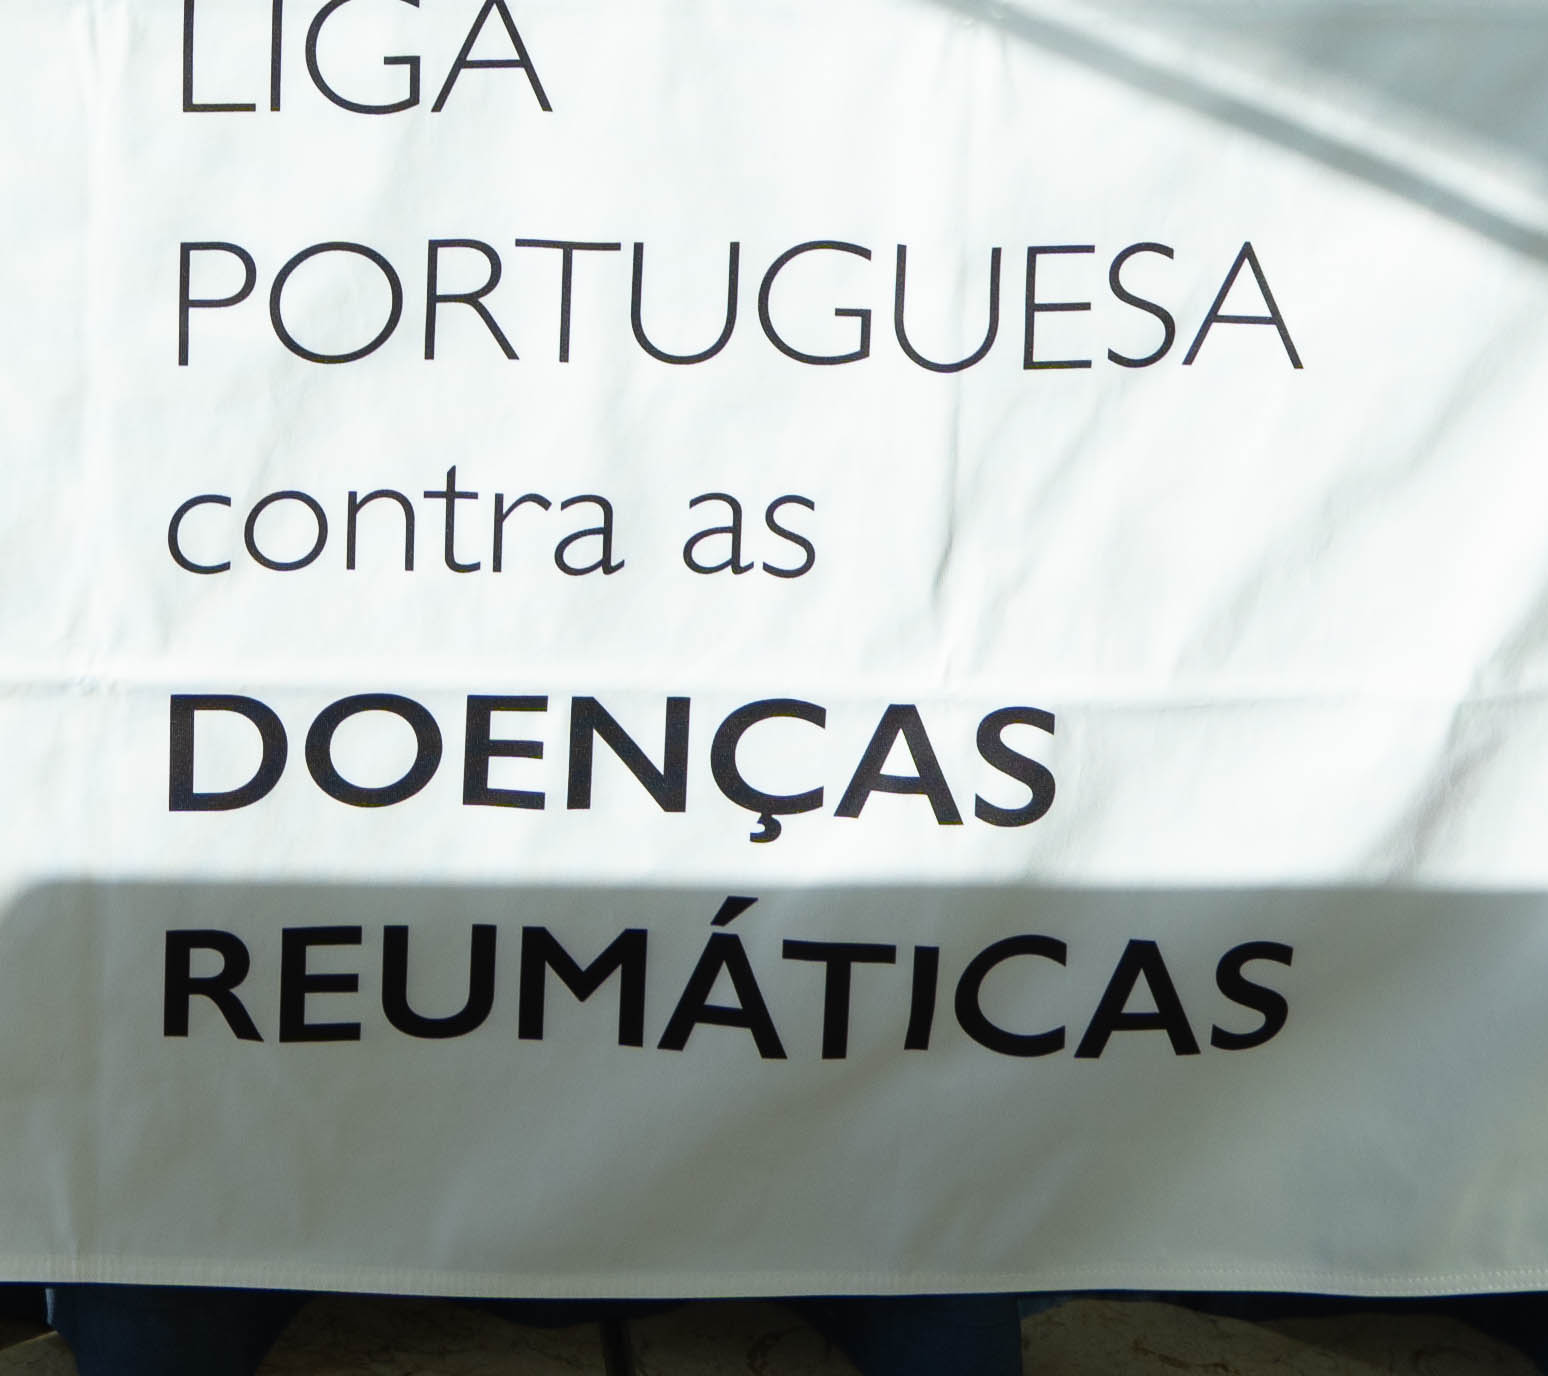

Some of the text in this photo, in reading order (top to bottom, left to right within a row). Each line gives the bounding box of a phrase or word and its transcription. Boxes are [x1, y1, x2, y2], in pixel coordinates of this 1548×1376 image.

[177, 236, 1304, 375] PORTUGUESA
[166, 464, 818, 579] contra as
[167, 691, 1057, 845] DOENÇAS
[161, 894, 1296, 1061] REUMÁTICAS
